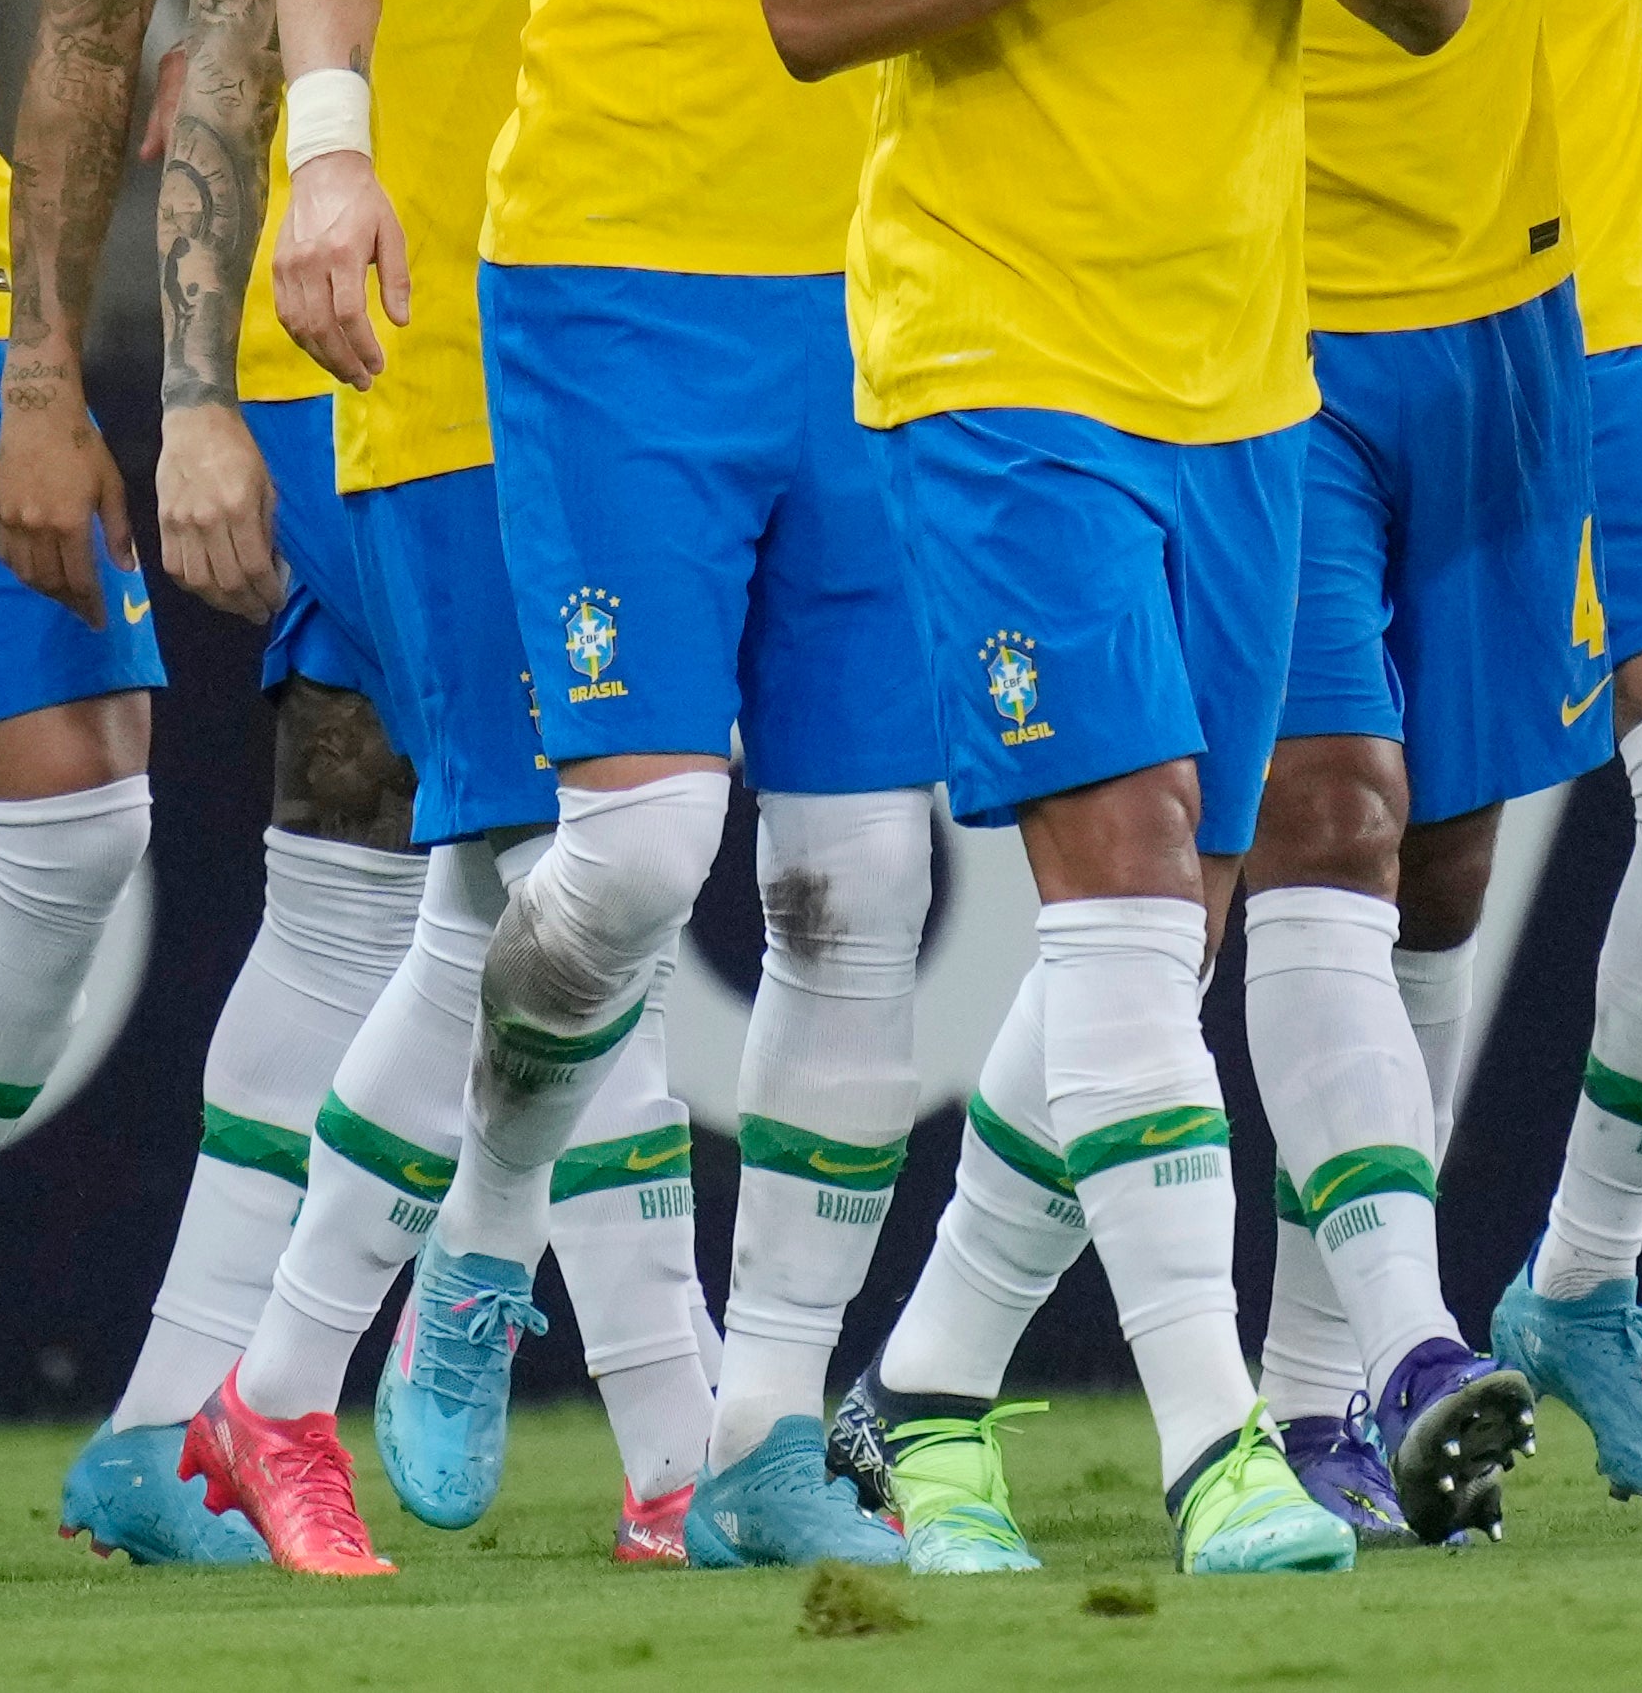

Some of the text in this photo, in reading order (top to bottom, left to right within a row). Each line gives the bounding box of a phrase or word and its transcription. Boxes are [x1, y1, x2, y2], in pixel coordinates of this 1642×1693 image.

[1571, 514, 1606, 660] 4
[579, 635, 600, 645] CBF
[568, 680, 629, 704] BRASIL
[1003, 676, 1022, 690] CBF
